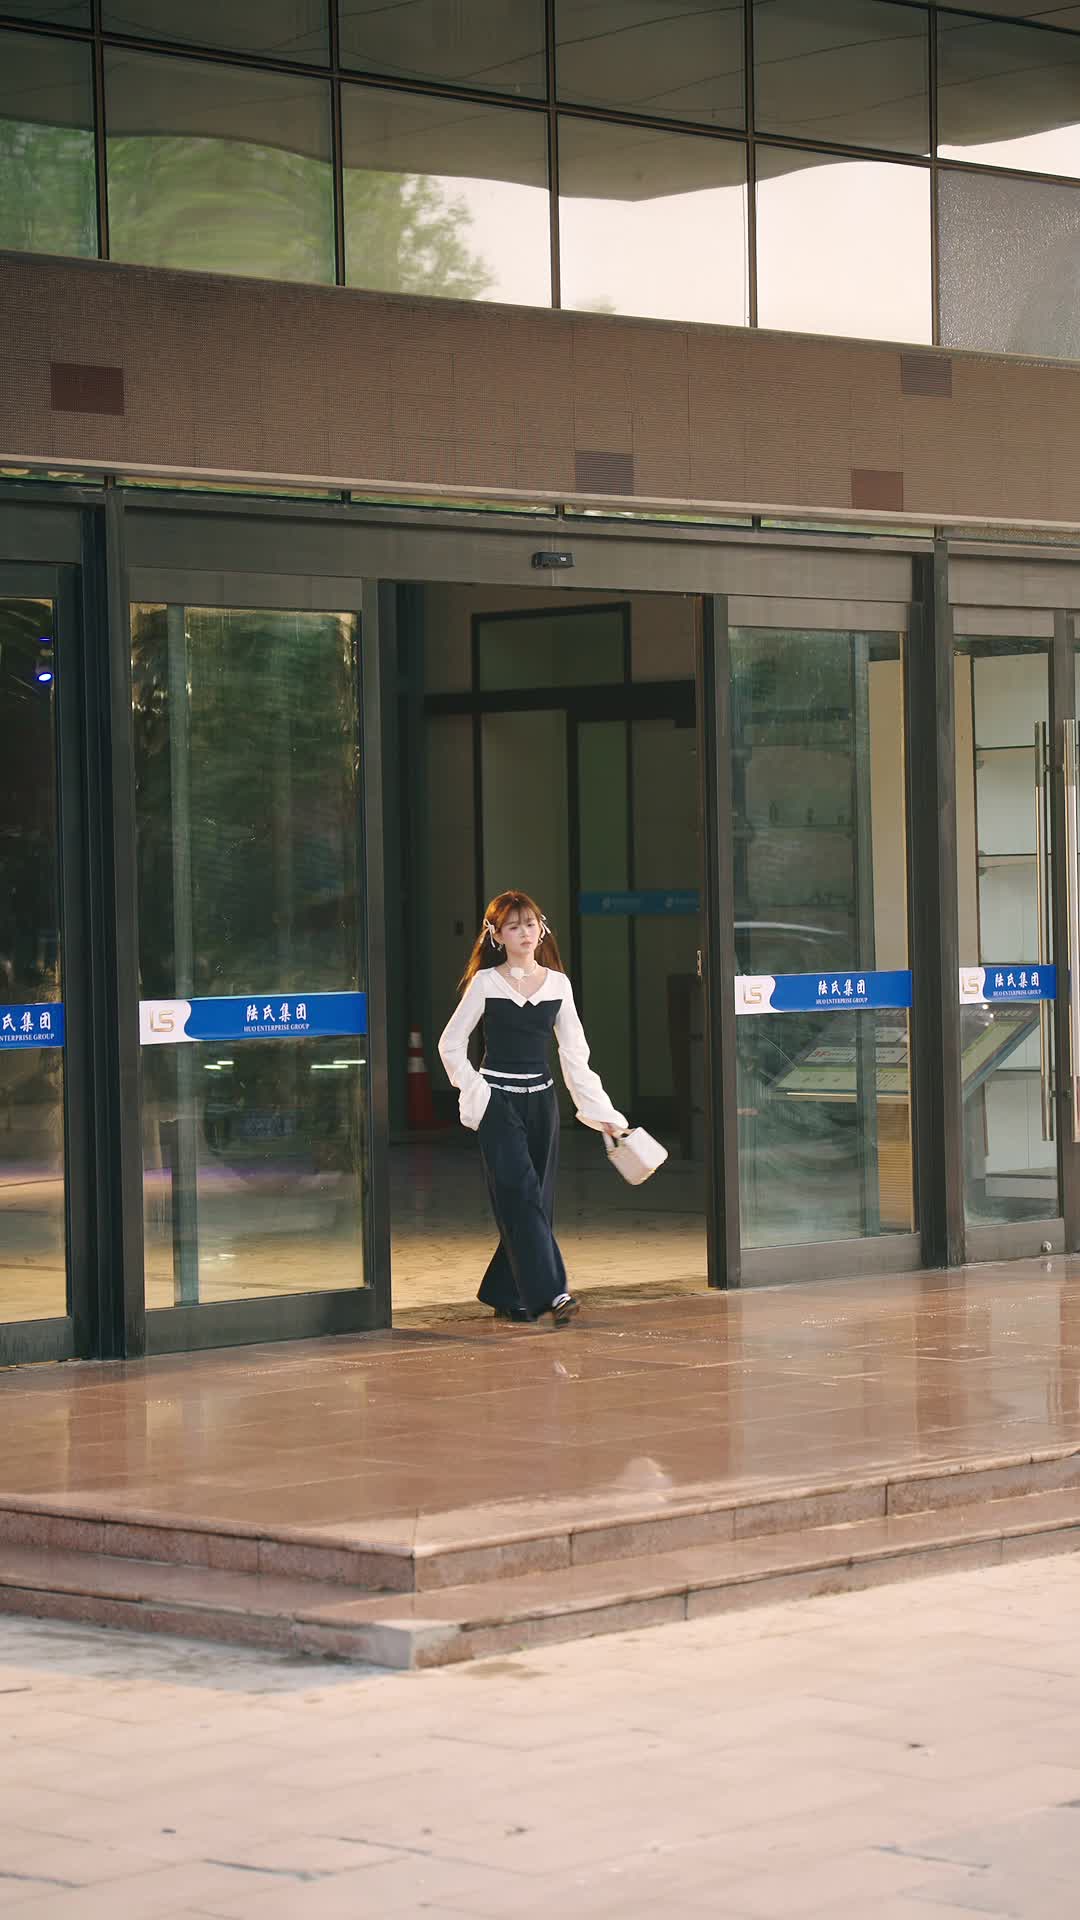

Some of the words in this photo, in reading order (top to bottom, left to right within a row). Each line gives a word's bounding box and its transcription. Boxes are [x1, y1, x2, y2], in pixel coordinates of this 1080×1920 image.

[818, 979, 866, 996] 陆氏集团
[994, 971, 1040, 988] 陆氏集团
[246, 1003, 307, 1023] 陆氏集团
[256, 1024, 290, 1032] ENTERPRISE
[290, 1023, 311, 1031] GROUP
[33, 1033, 55, 1041] GROUP
